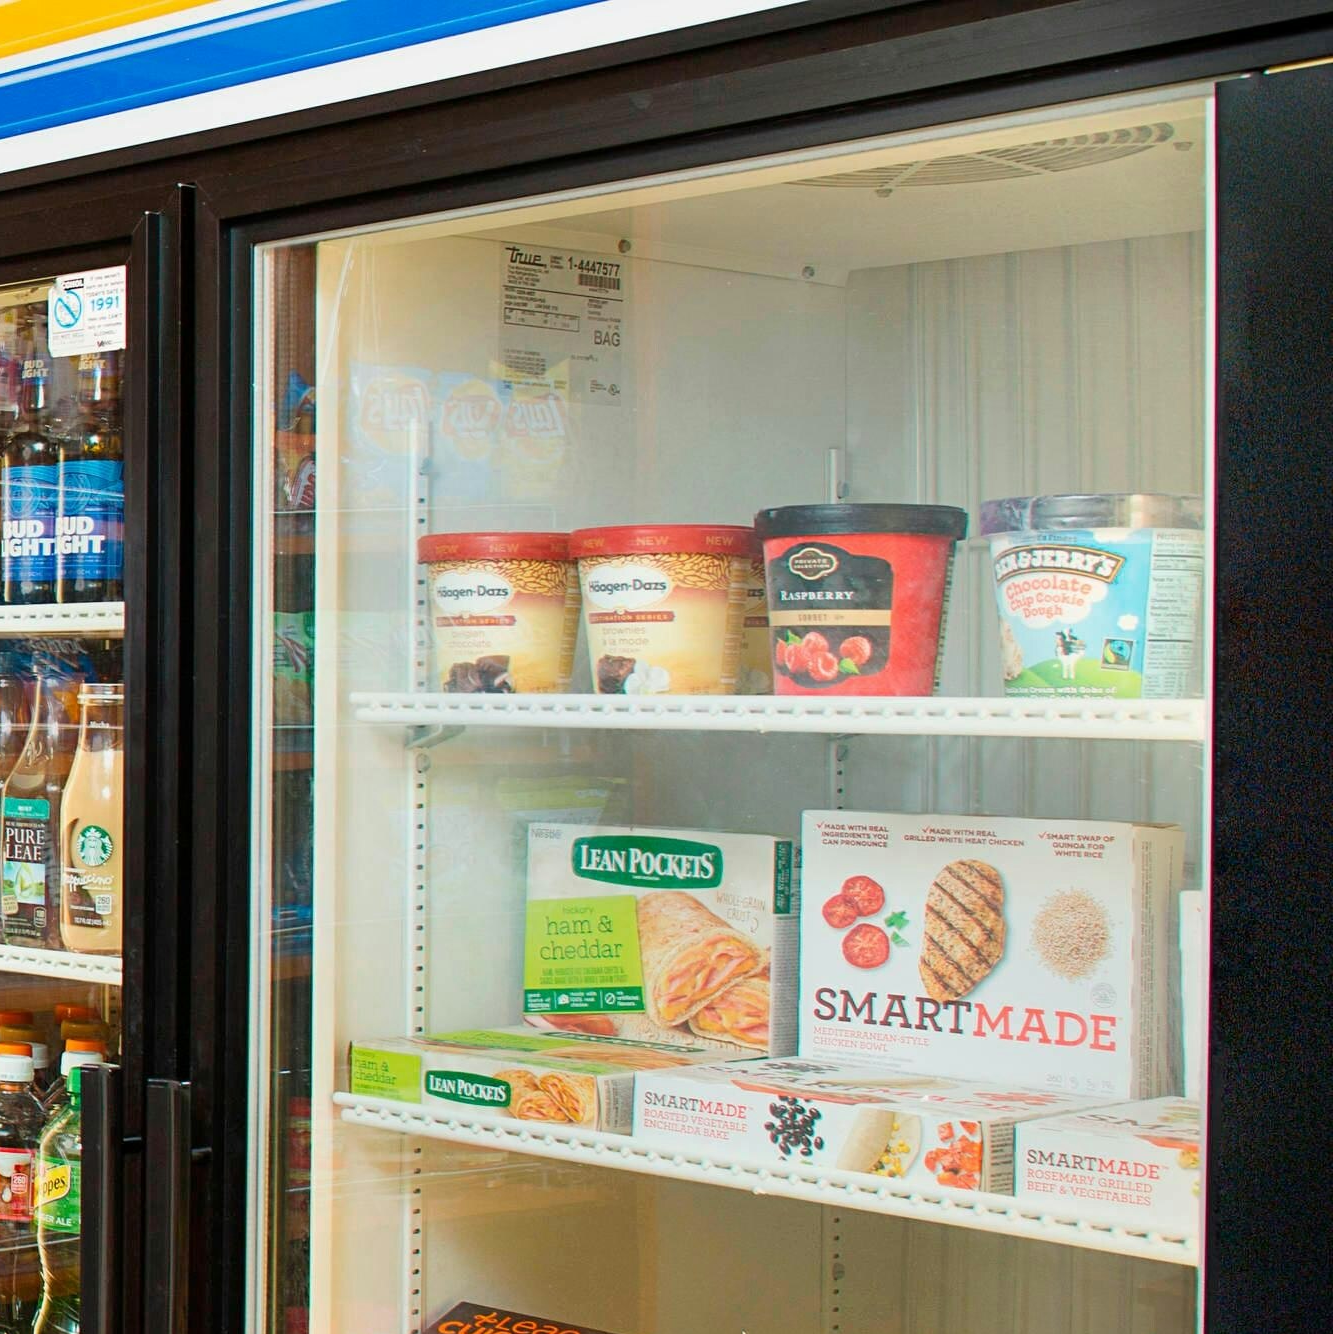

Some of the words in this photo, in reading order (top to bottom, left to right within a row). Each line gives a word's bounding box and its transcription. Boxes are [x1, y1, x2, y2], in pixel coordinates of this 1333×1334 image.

[568, 256, 621, 277] 1-4447577
[90, 295, 120, 312] 1991
[594, 329, 620, 347] BAG
[3, 520, 44, 539] BUD
[489, 543, 520, 553] NEW
[780, 590, 854, 601] RASPBERRY
[1010, 596, 1034, 612] Chip
[1035, 592, 1084, 606] Cookie
[798, 613, 828, 623] SORBET
[1022, 604, 1063, 619] Dough
[602, 625, 646, 635] brownies
[821, 831, 870, 841] INGREDIENTS
[824, 822, 851, 832] MADE
[853, 824, 870, 832] WITH
[872, 825, 889, 834] REAL
[1046, 832, 1073, 841] SMART
[842, 839, 889, 849] PRONOUNCE
[903, 834, 936, 843] GRILLED
[938, 835, 962, 845] WHITE
[1052, 841, 1085, 850] QUINOA
[581, 845, 628, 872] LEAN
[630, 848, 715, 879] POCKETS
[1083, 850, 1104, 859] RICE
[546, 916, 593, 936] ham
[540, 938, 622, 961] cheddar
[813, 986, 1117, 1052] SMARTMADE
[813, 1024, 930, 1047] MEDITERRANEAN-STYLE
[858, 1040, 888, 1053] BOWL
[429, 1074, 456, 1093] LEAN
[458, 1078, 507, 1103] POCKETS
[644, 1091, 748, 1119] SMARTMADE
[644, 1108, 687, 1123] ROASTED
[689, 1113, 748, 1133] VEGETABLE
[643, 1119, 700, 1138] ENCHILADA
[702, 1127, 730, 1141] BAKE
[1027, 1168, 1091, 1188] ROSEMARY
[1027, 1180, 1057, 1195] BEEF
[1070, 1186, 1152, 1207] VEGETABLES
[56, 1217, 72, 1227] ALE
